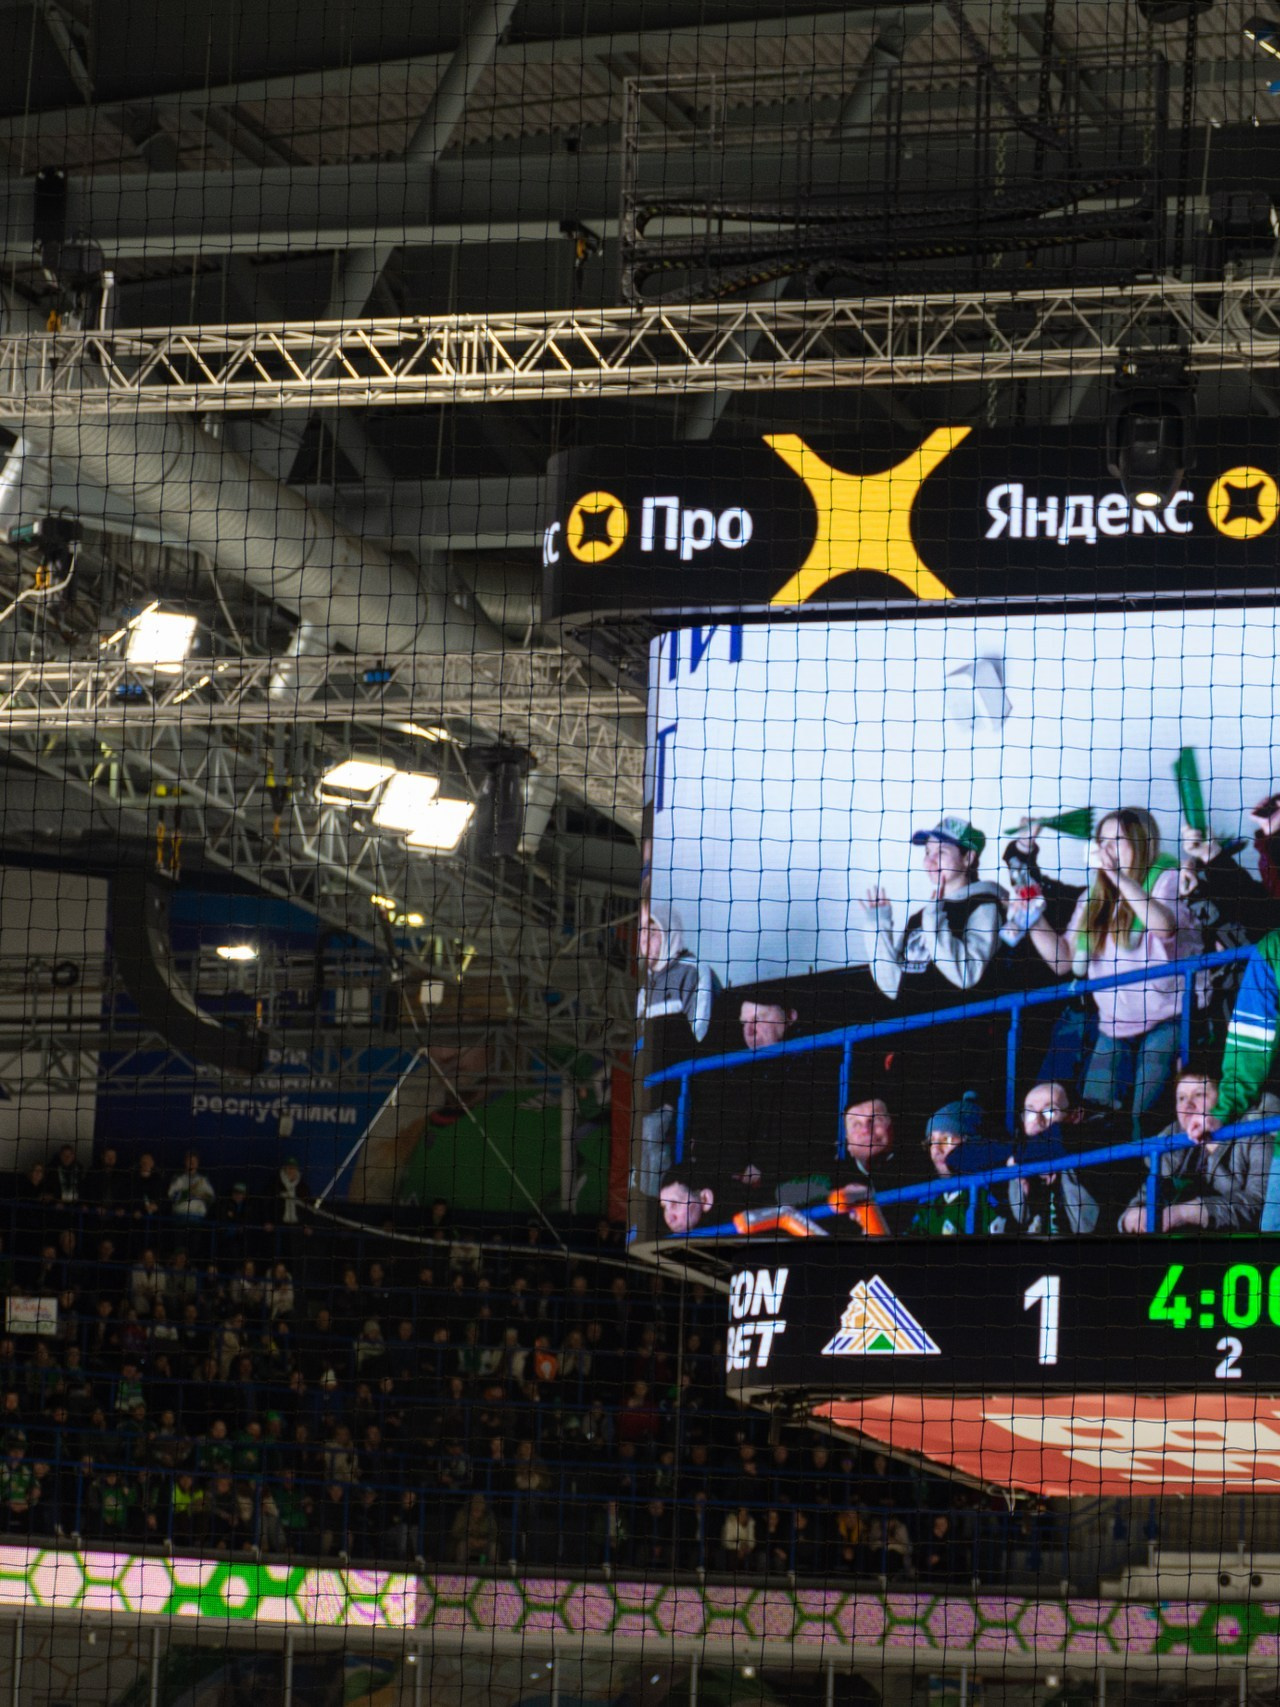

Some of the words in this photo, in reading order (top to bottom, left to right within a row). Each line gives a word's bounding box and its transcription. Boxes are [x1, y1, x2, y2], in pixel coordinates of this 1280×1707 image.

[640, 496, 753, 561] Про
[985, 483, 1194, 546] Яндекс
[1023, 1275, 1060, 1365] 1
[1215, 1336, 1243, 1378] 2
